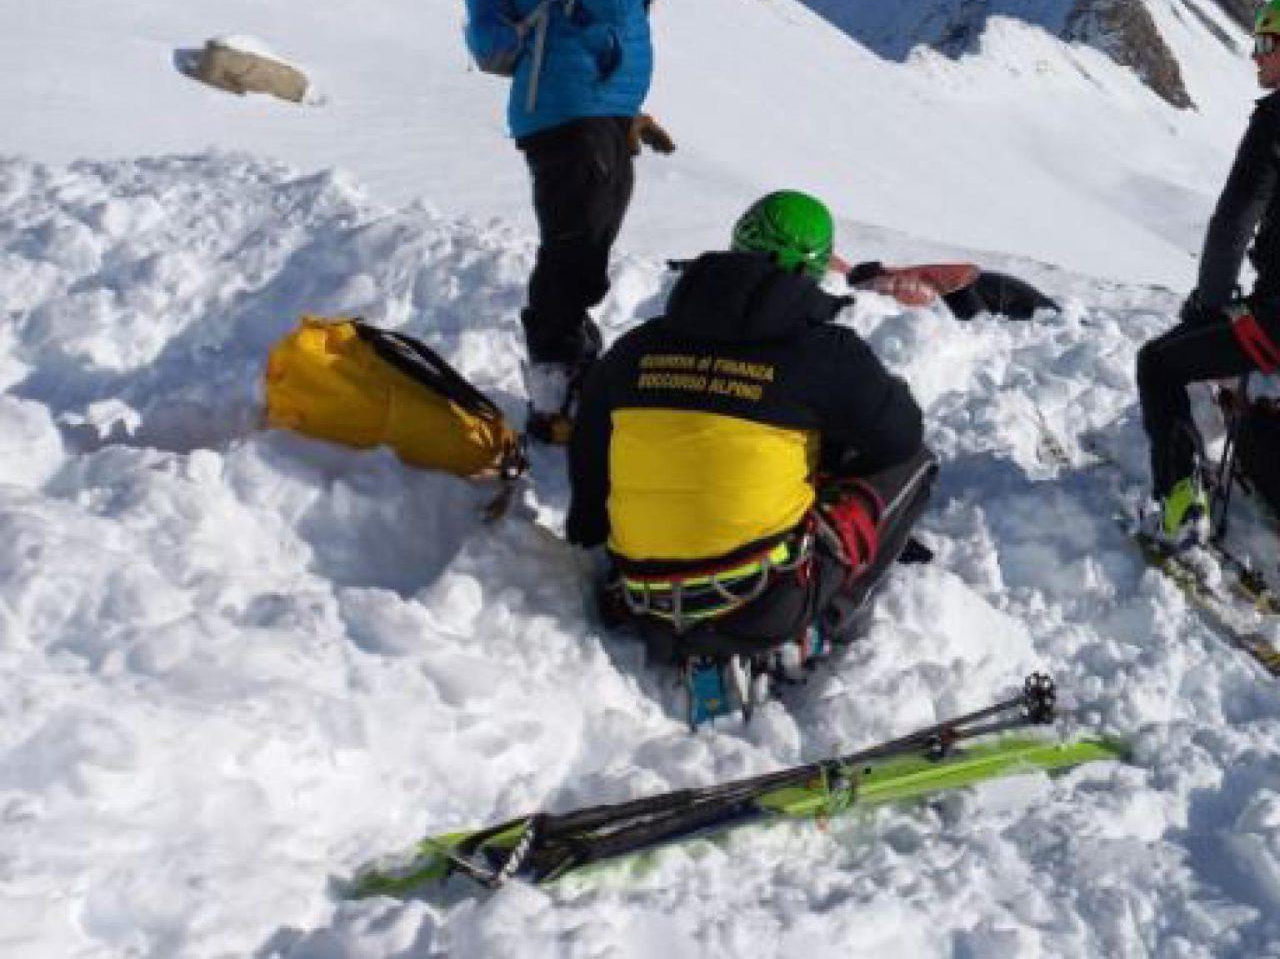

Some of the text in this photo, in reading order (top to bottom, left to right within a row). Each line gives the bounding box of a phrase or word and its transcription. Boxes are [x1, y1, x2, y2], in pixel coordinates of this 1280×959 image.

[714, 358, 774, 382] FINANZA
[638, 373, 763, 400] SOCCORSO ALPINO
